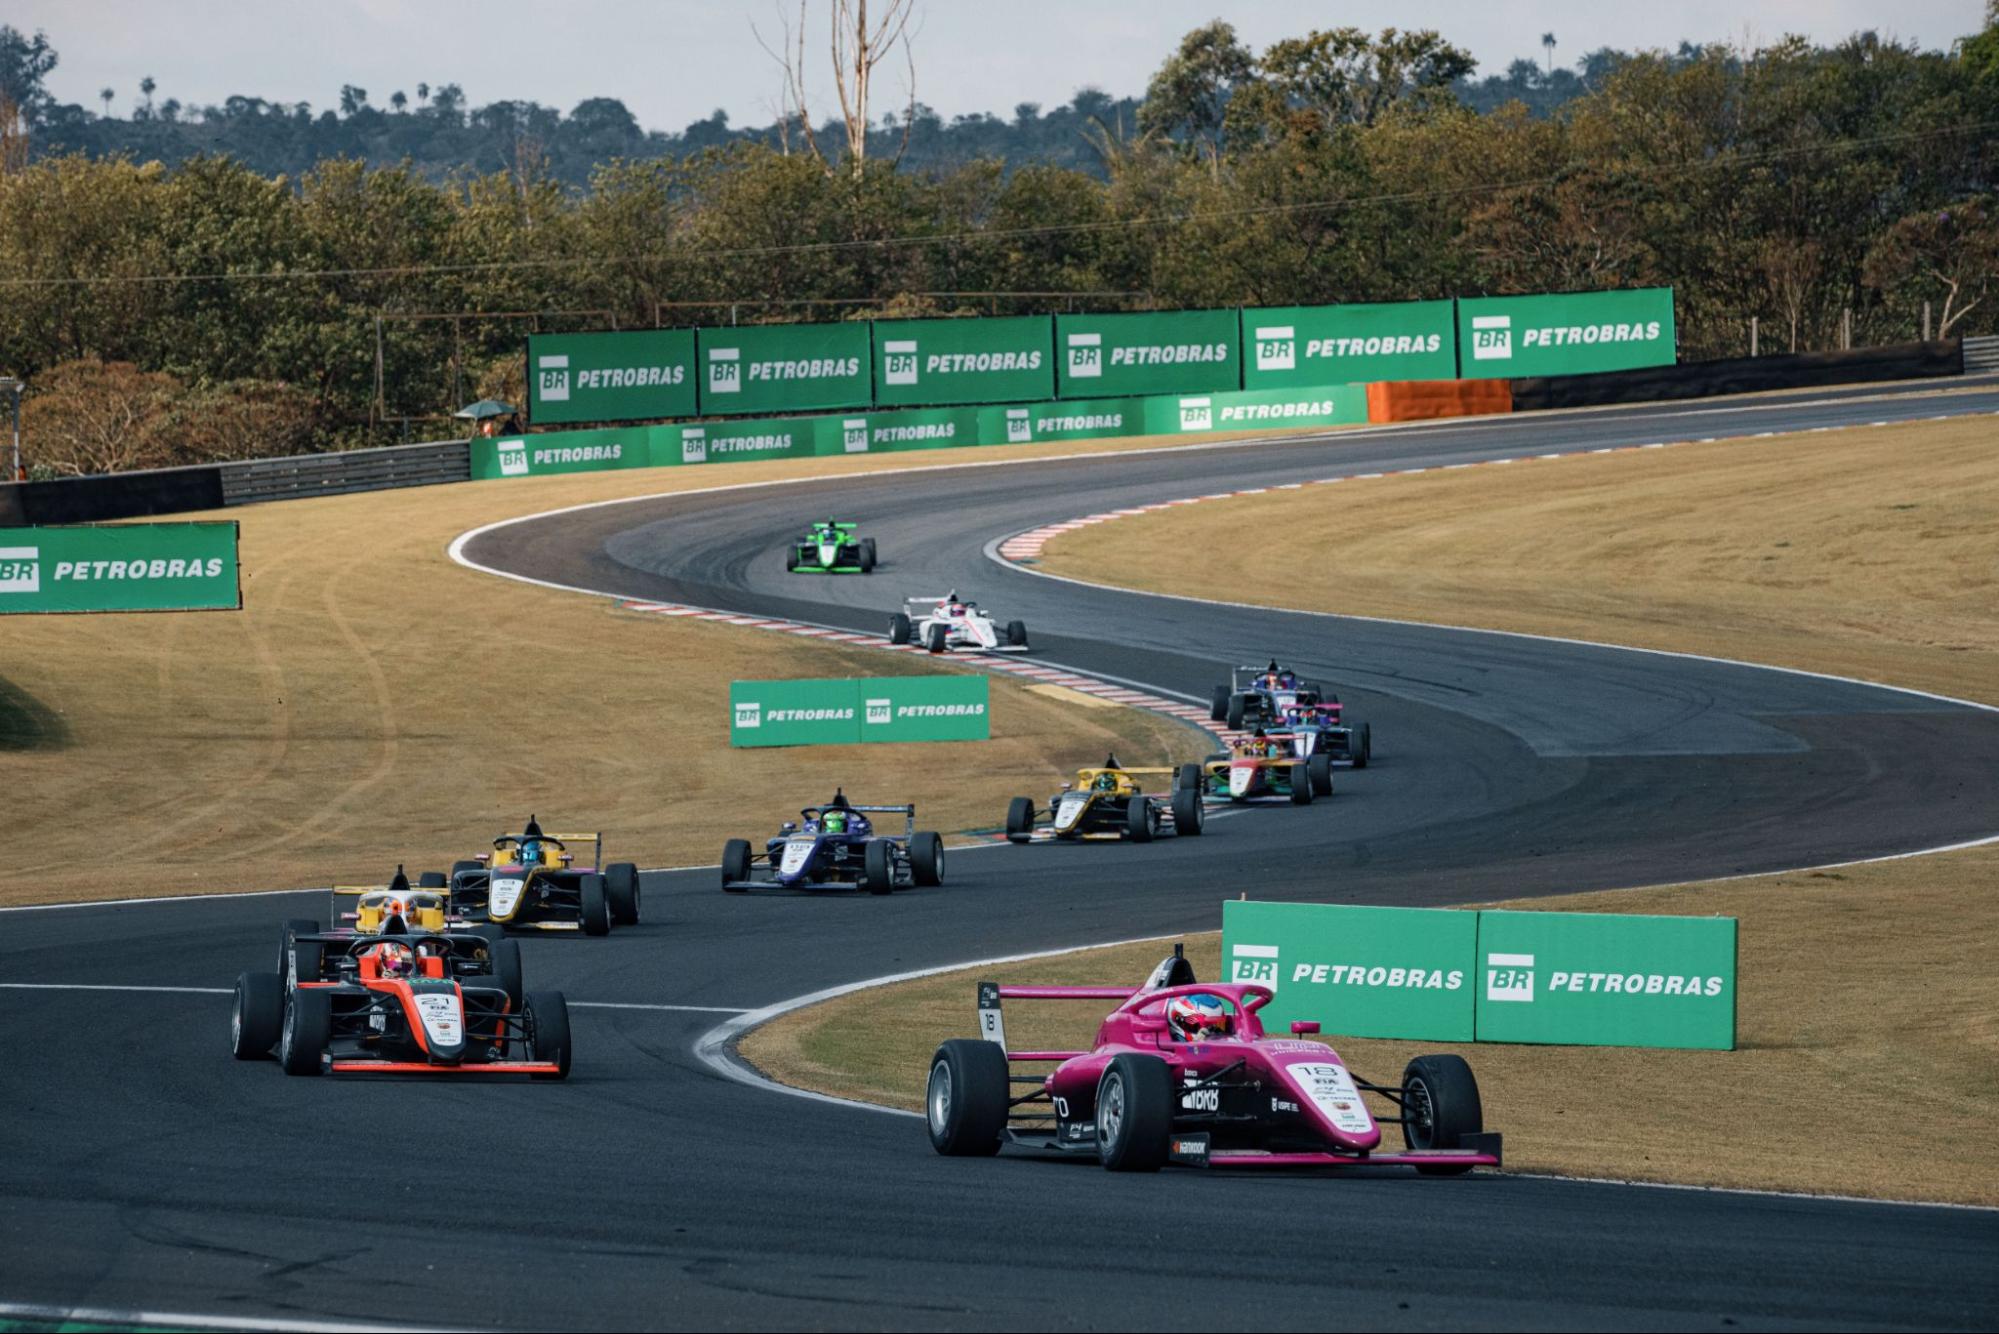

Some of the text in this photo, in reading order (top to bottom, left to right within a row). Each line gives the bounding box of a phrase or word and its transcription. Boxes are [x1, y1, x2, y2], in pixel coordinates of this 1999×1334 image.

[1476, 321, 1660, 348] BR PETROBRAS
[1072, 343, 1227, 365] BR PETROBRAS
[1261, 334, 1441, 359] BR PETROBRAS
[712, 357, 859, 382] BR PETROBRAS
[889, 350, 1042, 373] BR PETROBRAS
[542, 365, 685, 390] BR PETROBRAS
[1184, 400, 1334, 422] BR PETROBRAS
[847, 423, 955, 444] BR PETROBRAS
[1010, 413, 1122, 433] BR PETROBRAS
[503, 444, 623, 466] BR PETROBRAS
[685, 434, 792, 454] BR PETROBRAS
[0, 558, 223, 581] BR PETROBRAS
[767, 708, 854, 721] PETROBRAS
[897, 703, 985, 717] PETROBRAS
[1237, 960, 1464, 990] BR PETROBRAS
[1493, 970, 1723, 997] BR PETROBRAS
[985, 1013, 995, 1031] 18
[1298, 1067, 1338, 1076] 18
